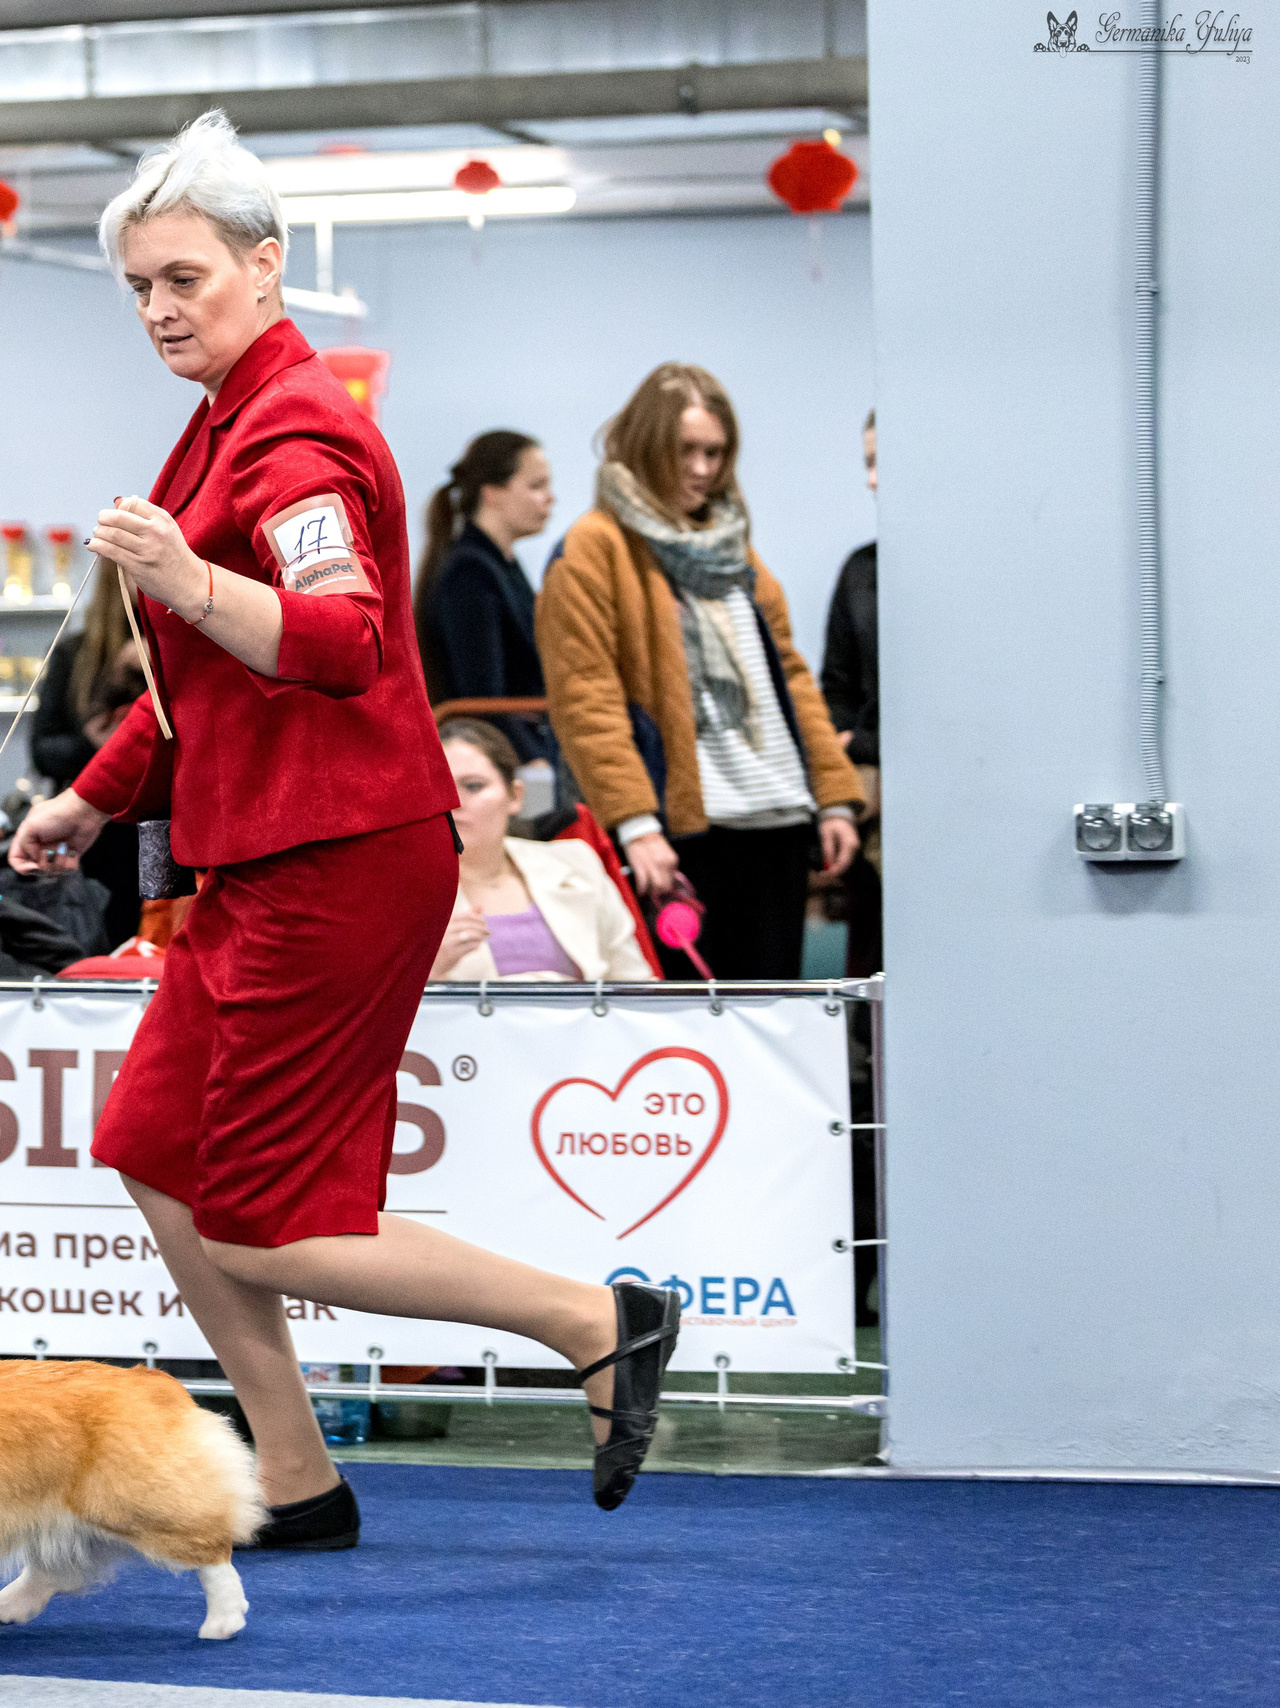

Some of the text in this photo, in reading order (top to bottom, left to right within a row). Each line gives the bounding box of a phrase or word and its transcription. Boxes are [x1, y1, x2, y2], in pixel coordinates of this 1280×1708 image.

[293, 515, 328, 564] 17
[295, 563, 354, 592] AlphaPet
[644, 1092, 705, 1115] ЭТО
[556, 1132, 692, 1156] ЛЮБОВЬ
[159, 1291, 184, 1317] и
